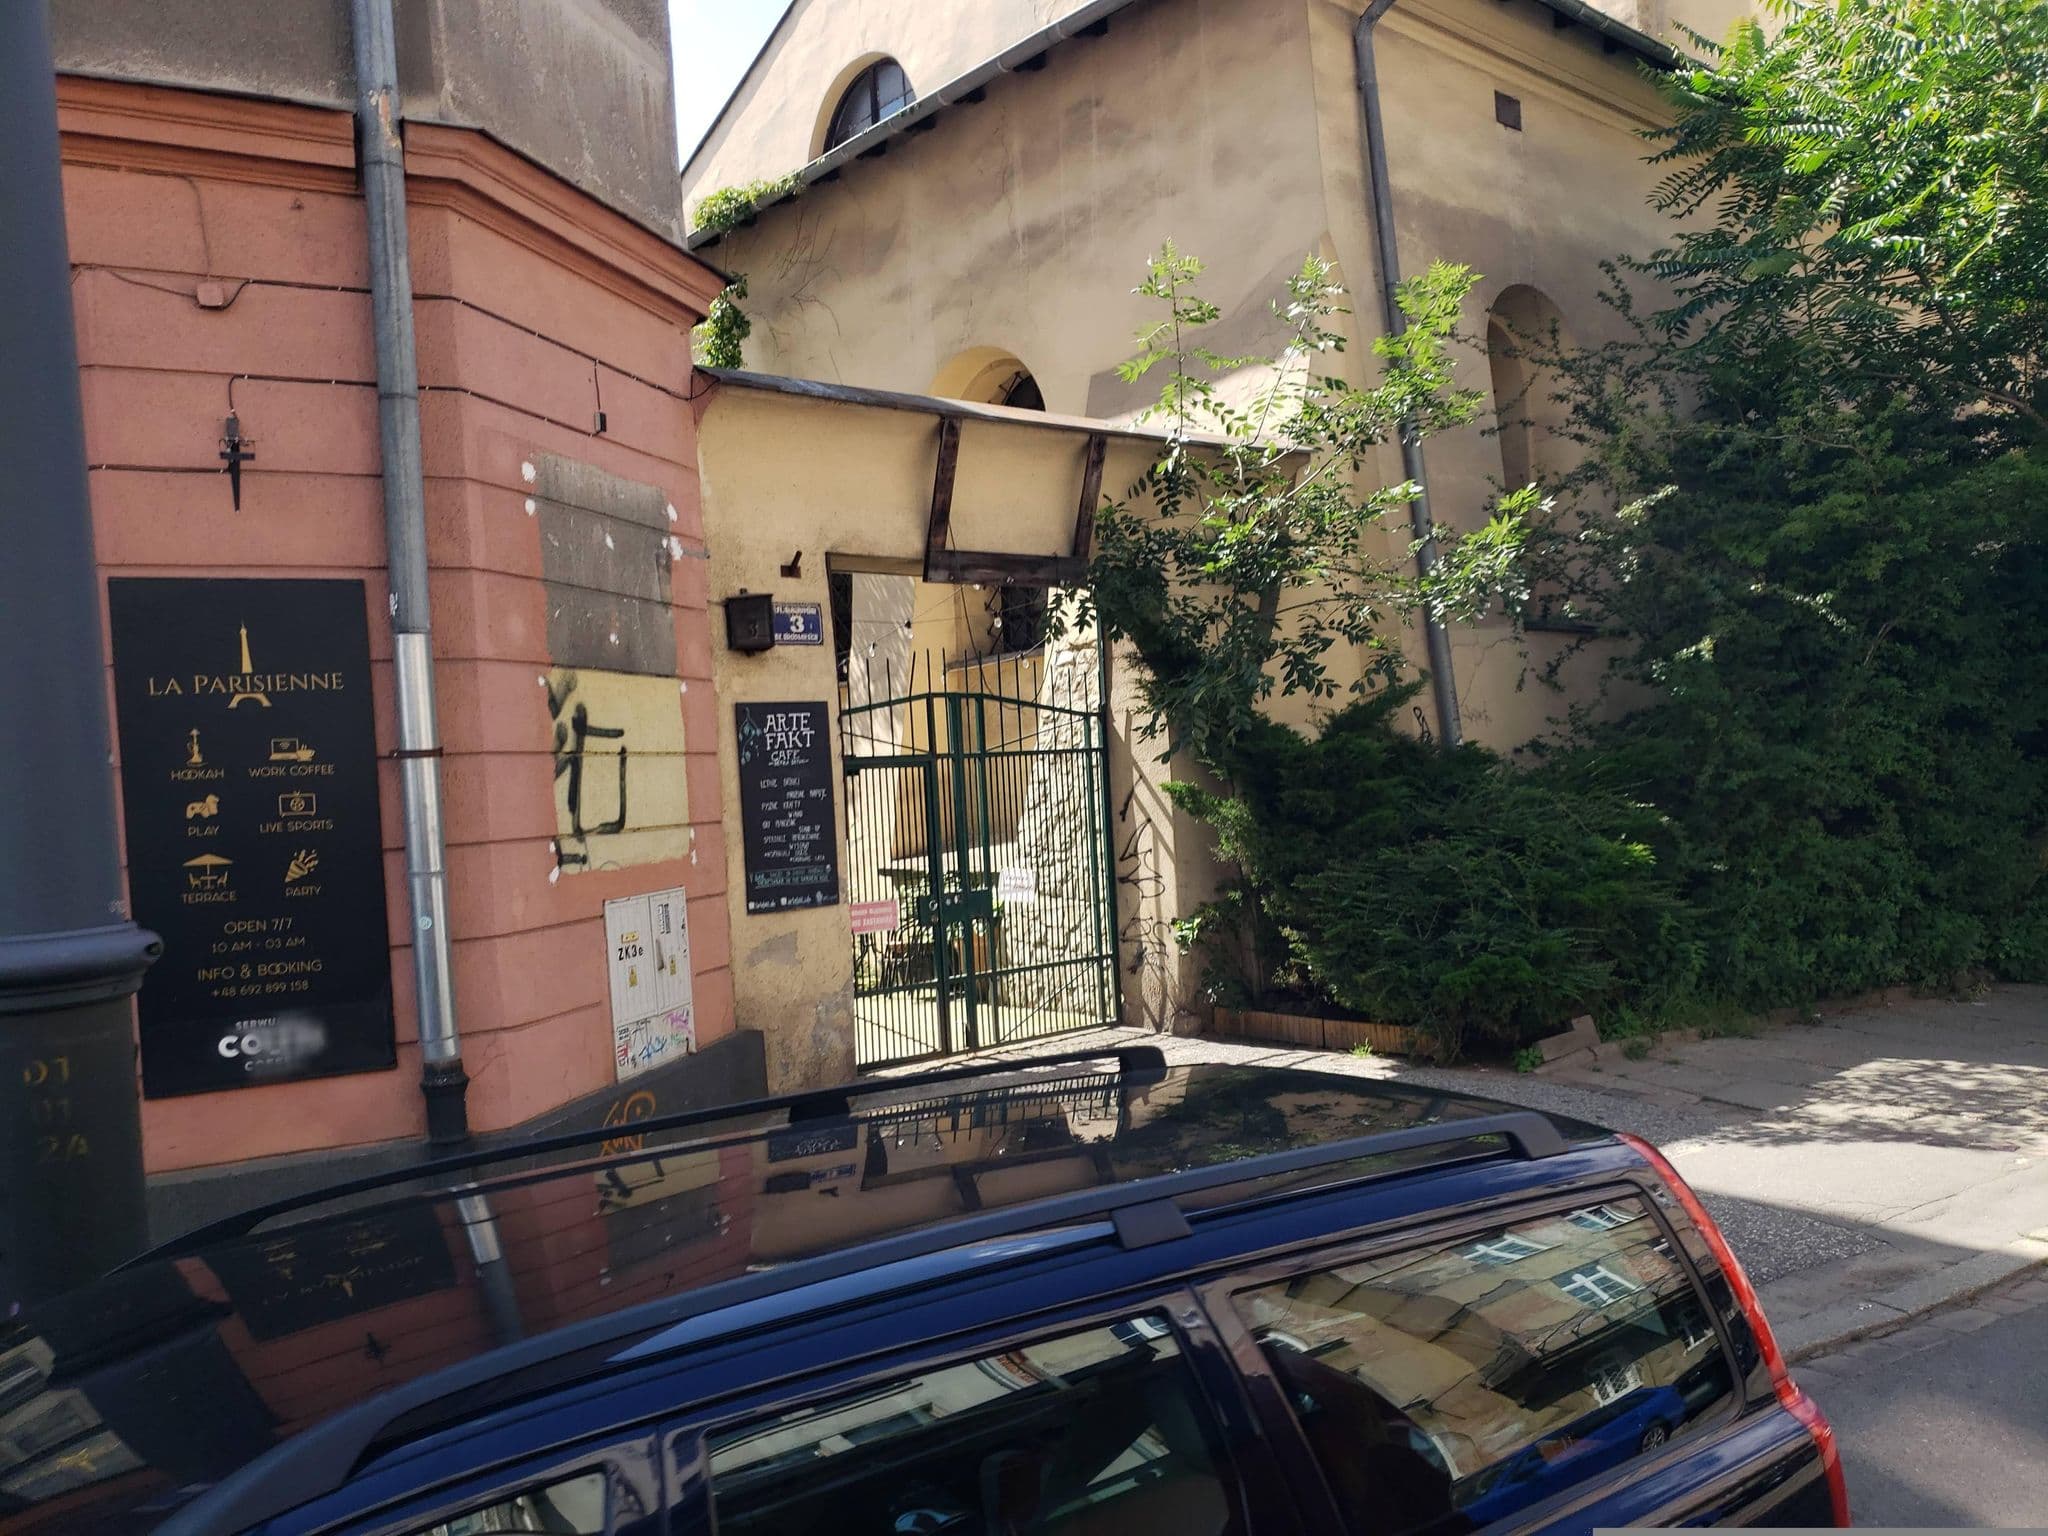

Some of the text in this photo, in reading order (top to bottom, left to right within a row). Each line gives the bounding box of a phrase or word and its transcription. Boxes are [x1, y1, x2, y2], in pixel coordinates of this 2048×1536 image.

[789, 615, 805, 633] 3
[148, 672, 344, 696] LA PARISIENNE
[764, 712, 811, 733] ARTE
[765, 730, 815, 751] FAKT
[171, 768, 224, 781] HOOKAH
[248, 764, 335, 777] WORK COFFEE
[188, 825, 220, 837] PLAY
[260, 818, 333, 833] LIVE SPORTS
[182, 890, 237, 904] TERRACE
[285, 885, 321, 897] PARTY
[224, 917, 293, 934] OPEN 7/7
[212, 941, 228, 953] 10
[231, 940, 252, 951] AM
[265, 937, 281, 949] 03
[285, 936, 306, 947] AM
[198, 959, 322, 981] INFO & BOOKING
[212, 985, 236, 997] +48
[240, 983, 262, 996] 692
